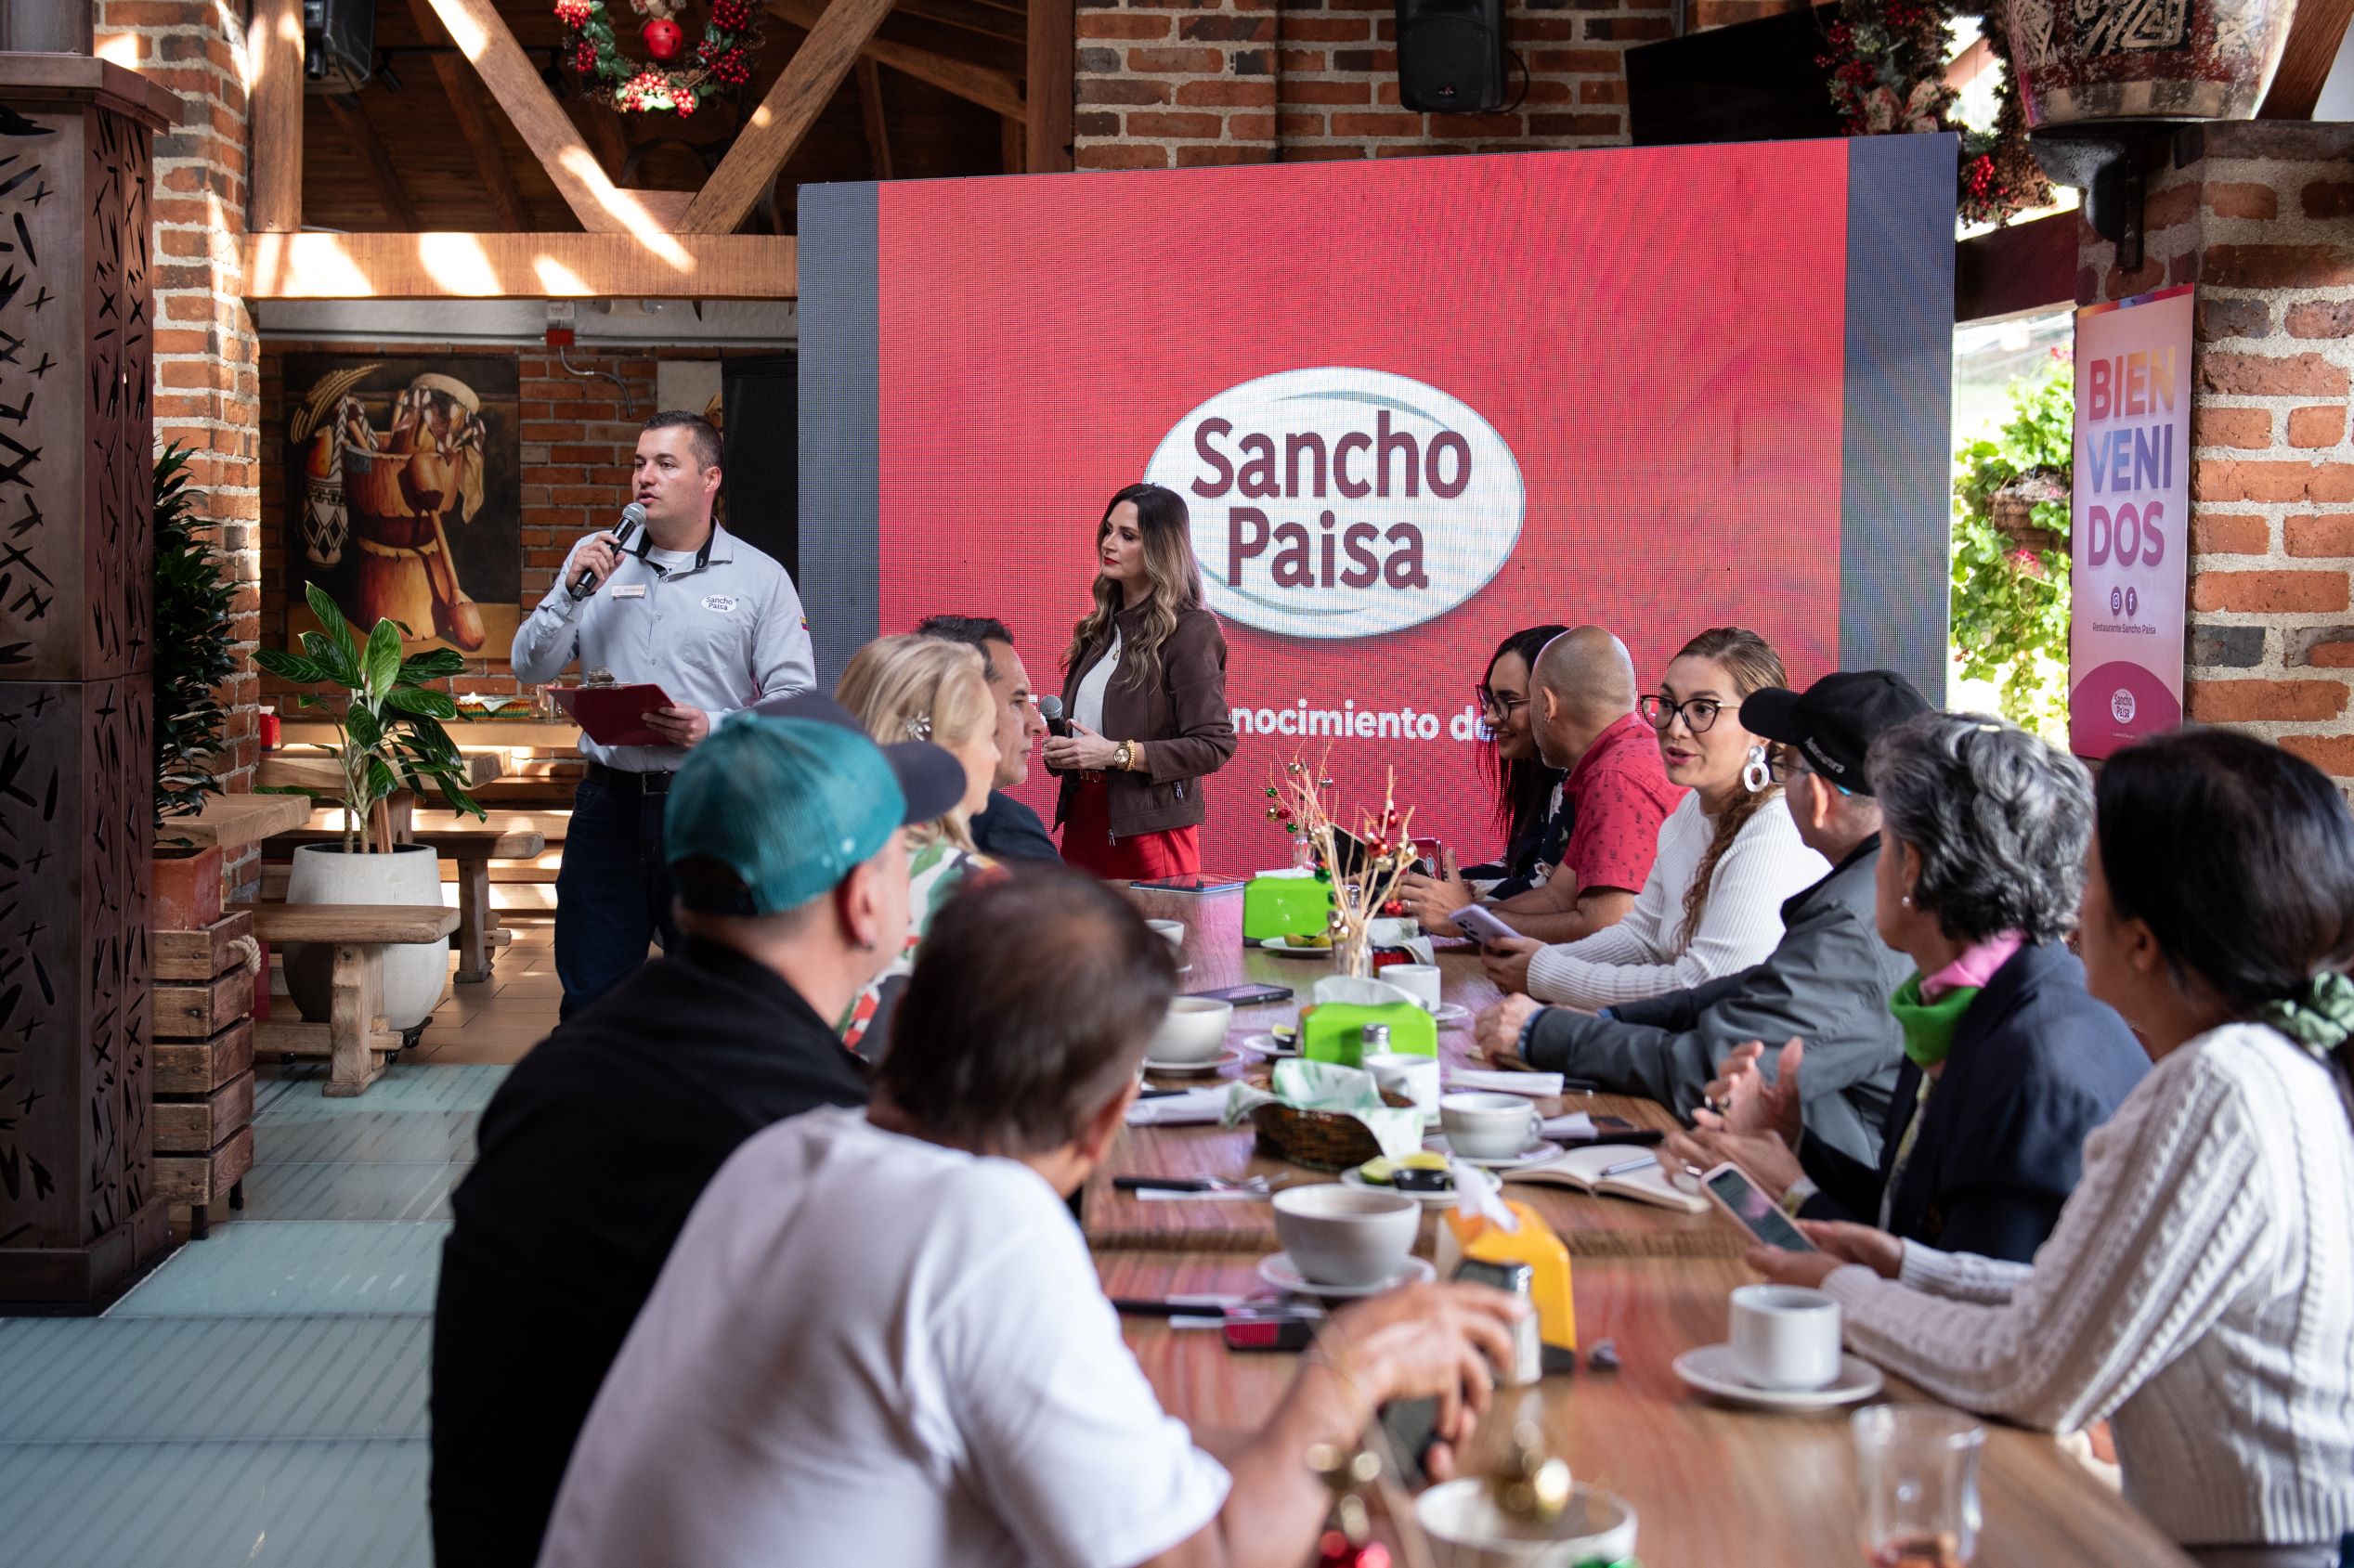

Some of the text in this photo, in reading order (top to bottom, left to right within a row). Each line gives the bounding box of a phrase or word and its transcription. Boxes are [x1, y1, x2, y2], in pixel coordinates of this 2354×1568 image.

[2088, 345, 2177, 421] BIEN
[1190, 409, 1473, 499] Sancho
[2087, 423, 2174, 493] VENI
[1228, 507, 1429, 590] Paisa
[2087, 500, 2165, 567] DOS
[706, 596, 734, 605] Sancho
[708, 603, 728, 611] Paisa
[2092, 622, 2156, 635] Restaurante Sancho Paisa
[1228, 698, 1440, 740] nocimiento
